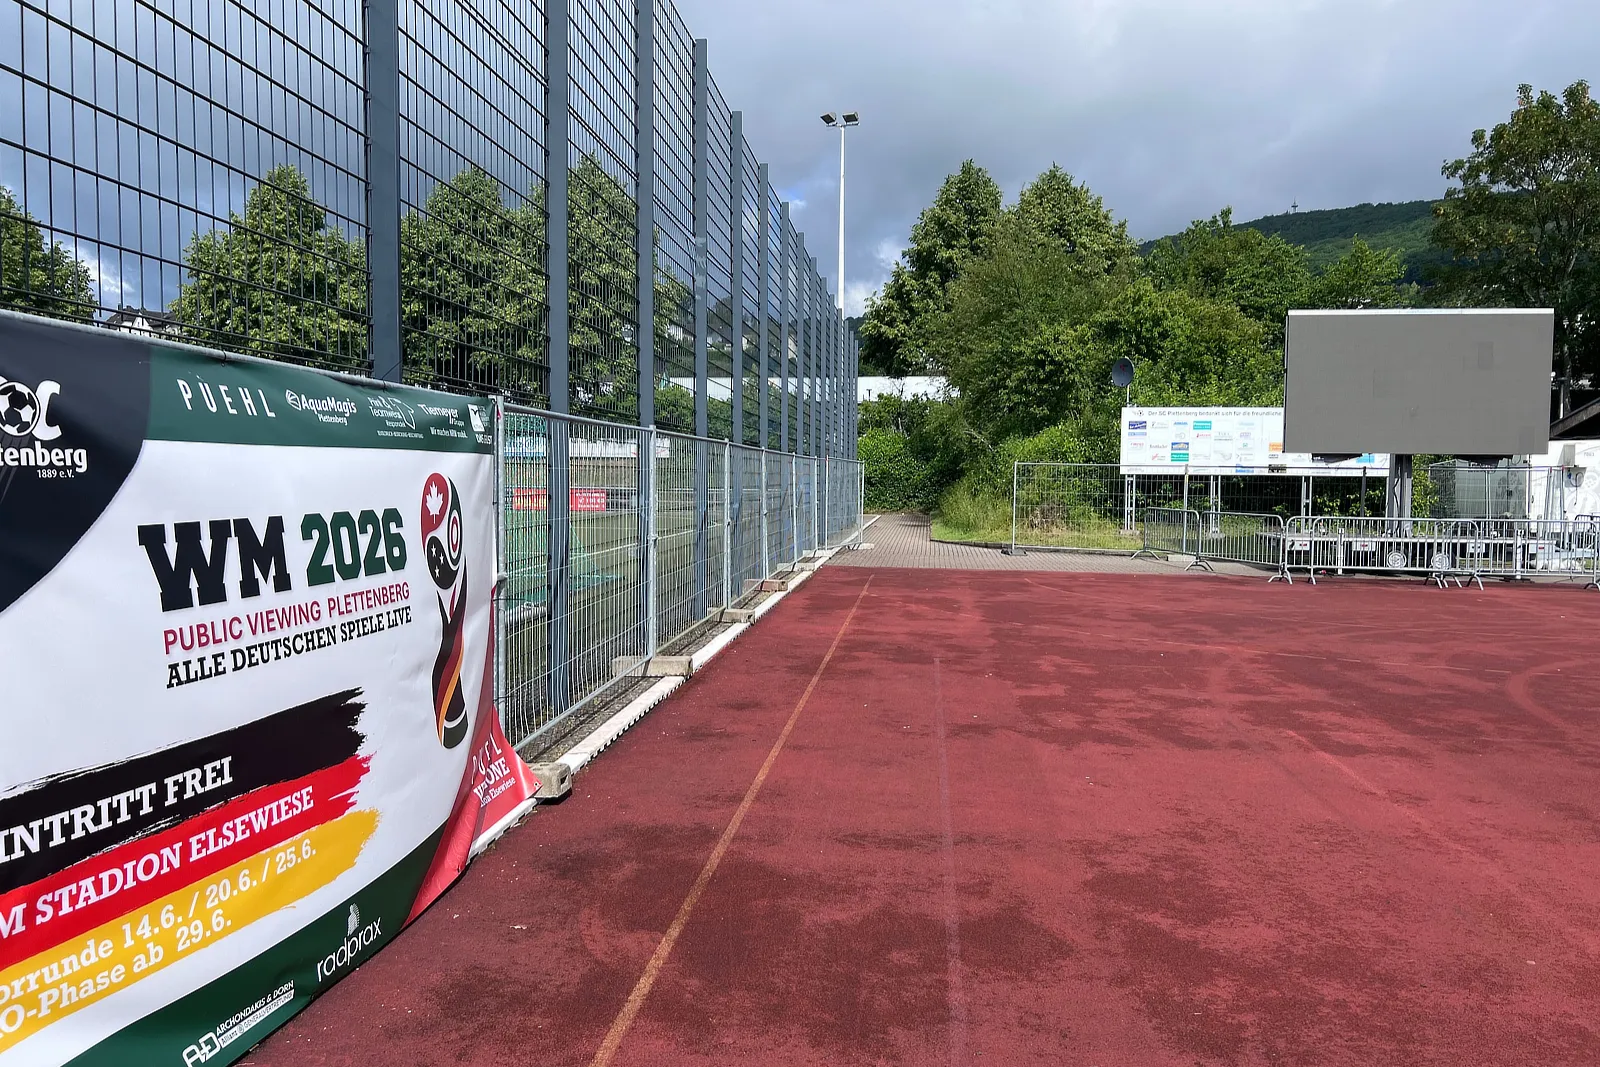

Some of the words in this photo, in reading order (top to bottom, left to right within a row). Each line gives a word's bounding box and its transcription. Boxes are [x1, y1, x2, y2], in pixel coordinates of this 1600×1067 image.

[301, 393, 357, 417] AquaMagis
[317, 413, 348, 426] Plettenberg
[417, 403, 459, 424] Tiemeyer
[37, 468, 57, 478] 1889
[59, 469, 75, 478] e.V.
[137, 516, 292, 612] WM
[300, 507, 407, 587] 2026
[164, 616, 243, 655] PUBLIC
[246, 600, 321, 636] VIEWING
[328, 581, 411, 618] PLETTENBERG
[166, 651, 227, 689] ALLE
[232, 624, 338, 672] DEUTSCHEN
[340, 615, 385, 643] SPIELE
[386, 605, 412, 630] LIVE
[0, 782, 158, 864] INTRITT
[164, 755, 233, 807] FREI
[35, 842, 183, 926] STADION
[189, 785, 315, 863] ELSEWIESE
[122, 903, 183, 949] 14.6.
[188, 891, 199, 918] /
[205, 867, 257, 909] 20.6.
[261, 857, 270, 882] /
[275, 838, 317, 874] 25.6.
[0, 962, 125, 1039] O-Phase
[132, 940, 164, 974] ab
[176, 908, 232, 953] 29.6.
[317, 917, 382, 982] radprax
[216, 997, 266, 1036] ARCHONDAKIS
[266, 993, 272, 1003] &
[273, 979, 294, 999] DORN
[221, 1030, 238, 1046] Allianz
